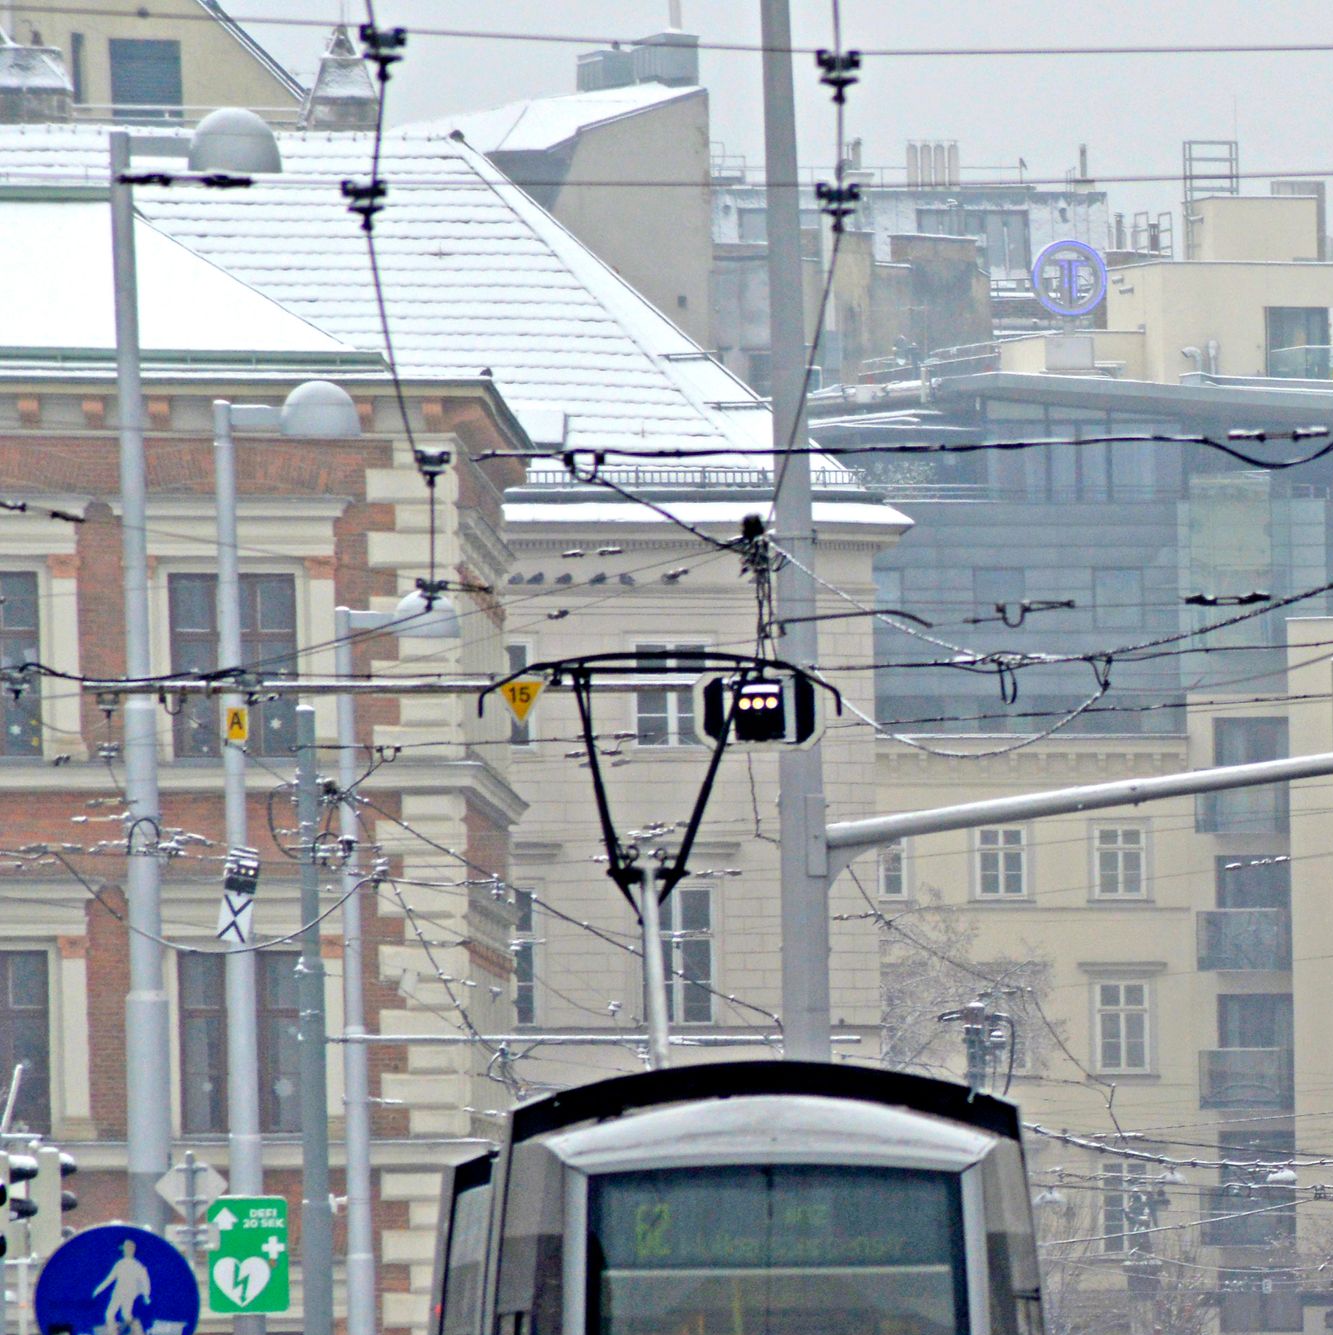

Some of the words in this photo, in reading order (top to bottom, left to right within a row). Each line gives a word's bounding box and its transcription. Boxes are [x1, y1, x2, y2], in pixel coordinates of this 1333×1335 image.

[508, 686, 530, 704] 15
[229, 713, 243, 730] A
[249, 1208, 278, 1218] DEFI
[243, 1218, 258, 1228] 20
[260, 1218, 285, 1228] SEK
